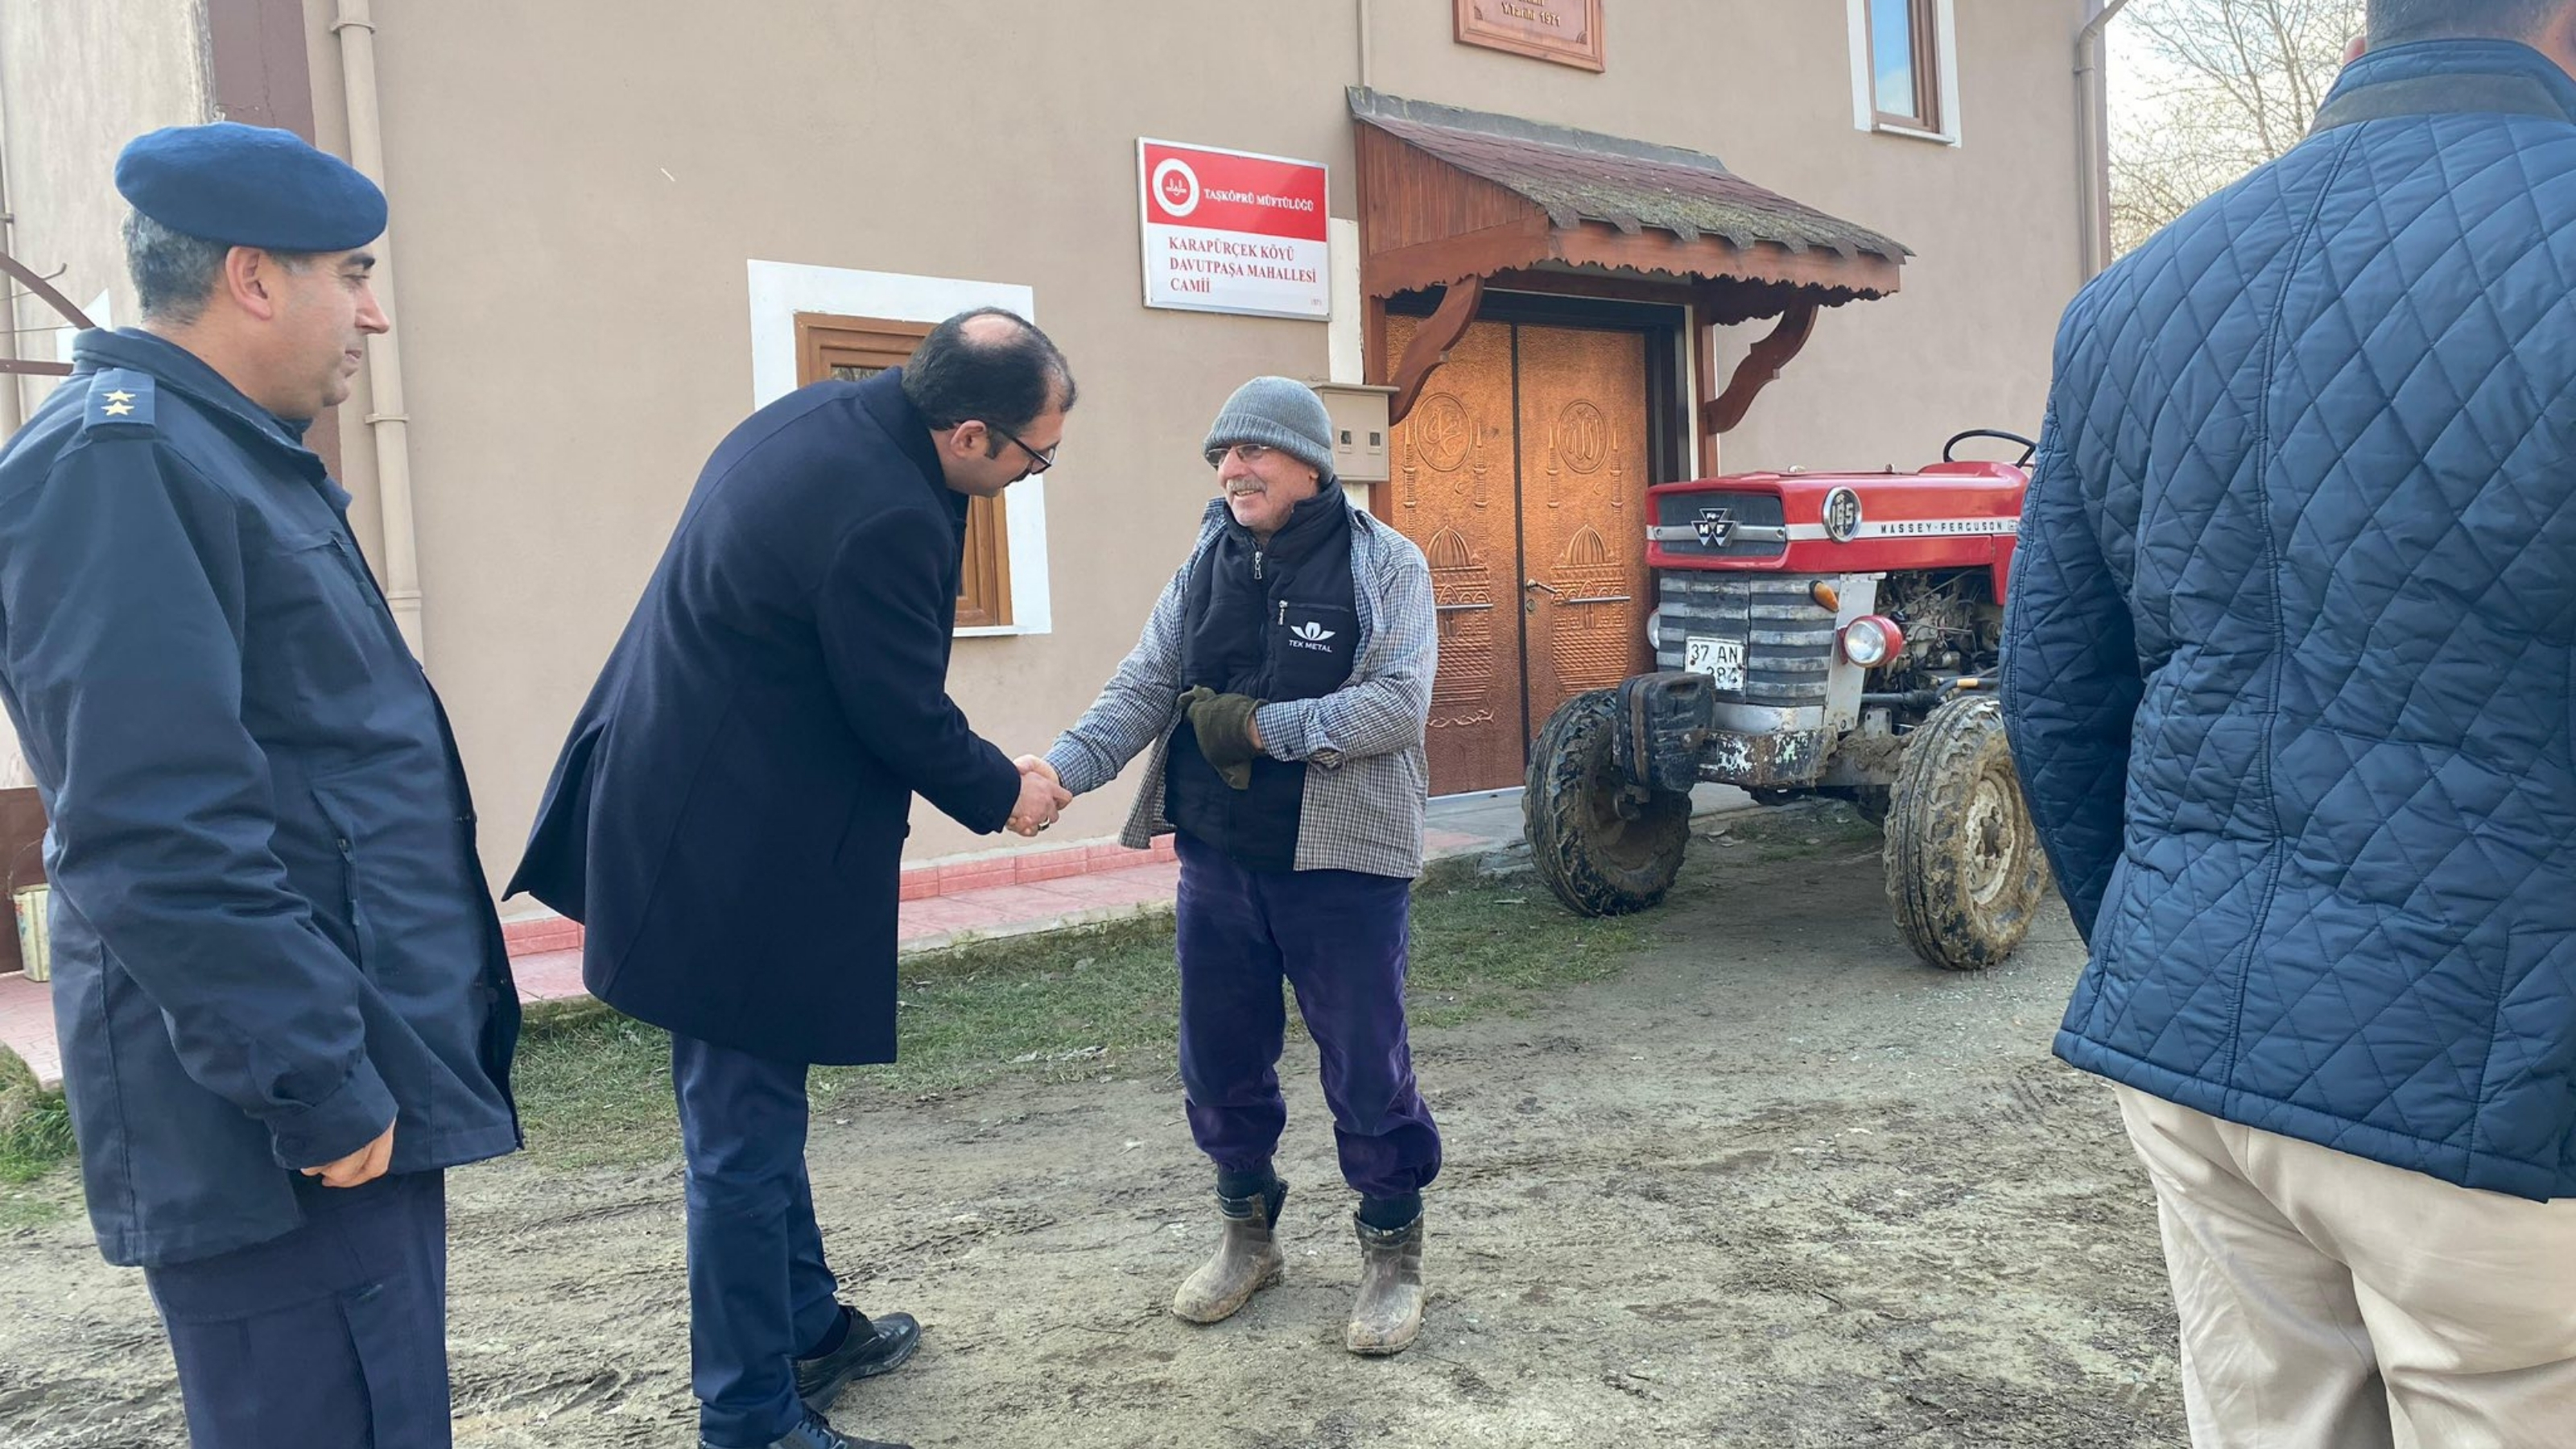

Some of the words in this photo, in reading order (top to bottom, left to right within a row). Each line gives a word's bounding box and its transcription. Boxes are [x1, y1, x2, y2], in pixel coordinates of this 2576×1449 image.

[1539, 11, 1561, 27] 1971
[1203, 188, 1254, 204] TAŞKÖPRÜ
[1169, 236, 1257, 258] KARAPÜRÇEK
[1261, 243, 1294, 261] KÖYÜ
[1170, 257, 1244, 278] DAVUTPAŞA
[1247, 264, 1316, 283] MAHALLESİ
[1170, 278, 1210, 292] CAMİİ
[1305, 642, 1332, 653] METAL
[1691, 643, 1709, 662] 37
[1717, 646, 1738, 663] AN
